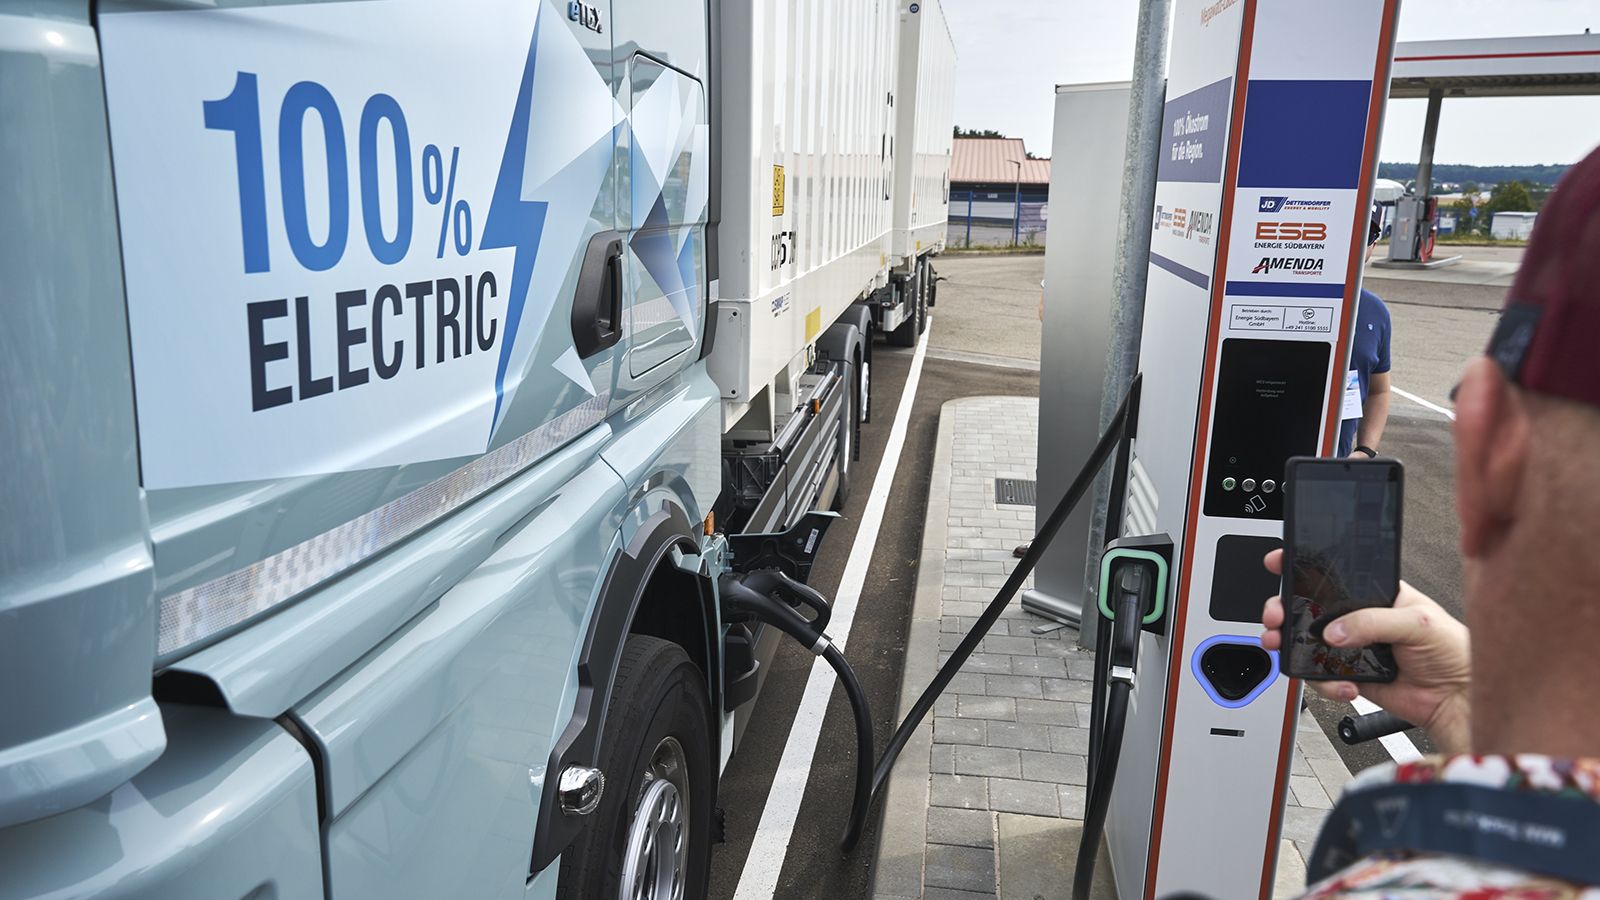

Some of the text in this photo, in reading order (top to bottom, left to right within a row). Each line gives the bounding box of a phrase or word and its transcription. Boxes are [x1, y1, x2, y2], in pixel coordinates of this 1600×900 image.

[202, 71, 472, 274] 100%
[1261, 200, 1275, 209] JD
[1255, 222, 1327, 241] ESB
[1284, 242, 1325, 250] SÜDBAYERN
[1252, 257, 1324, 274] AMENDA
[246, 270, 498, 412] ELECTRIC
